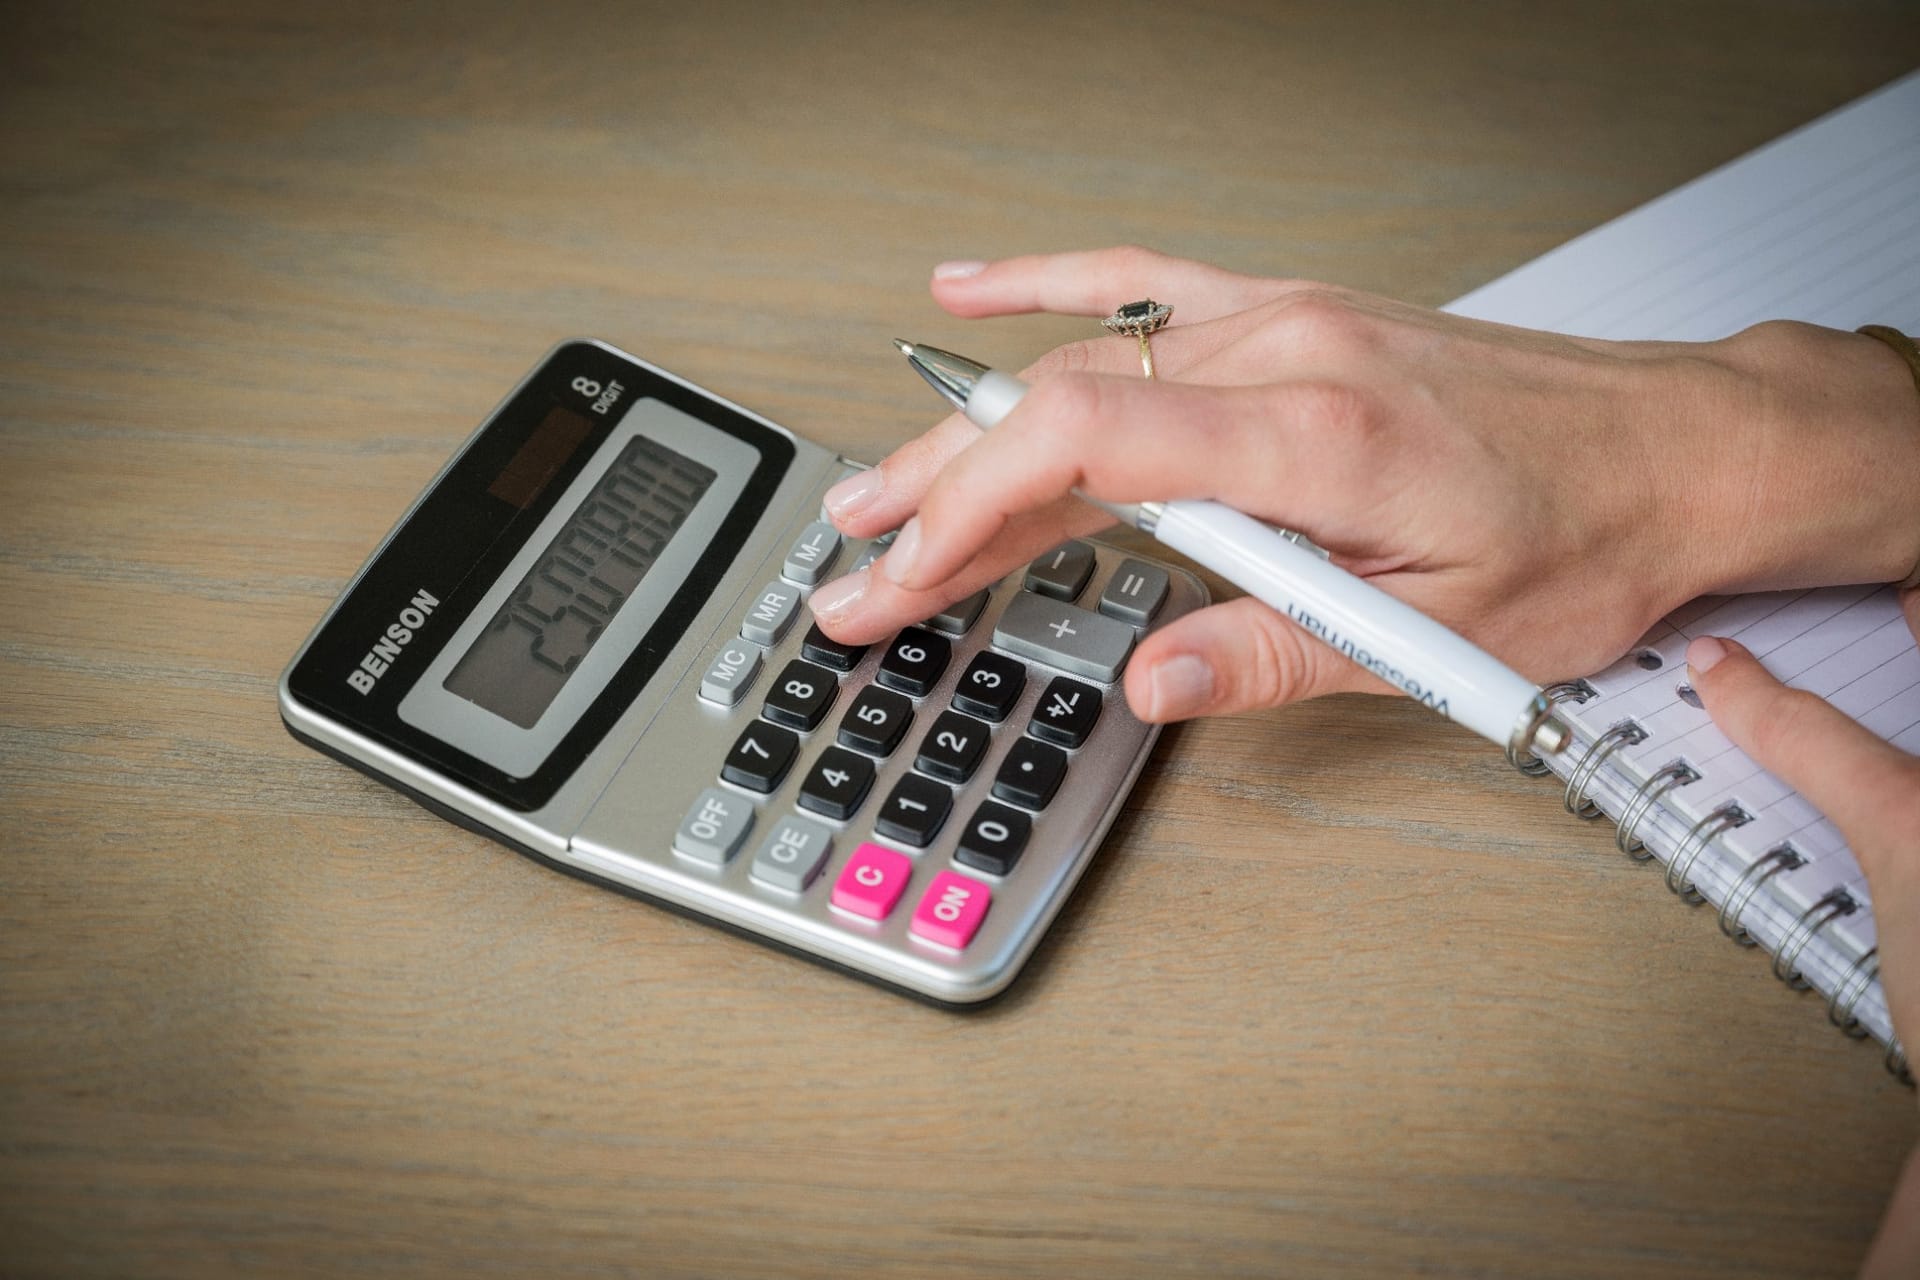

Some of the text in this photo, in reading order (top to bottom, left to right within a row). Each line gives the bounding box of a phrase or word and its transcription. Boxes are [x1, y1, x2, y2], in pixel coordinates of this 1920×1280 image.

[571, 376, 600, 398] 8
[592, 379, 626, 414] DIGIT
[753, 591, 788, 623] MR
[346, 588, 441, 696] BENSON
[898, 644, 927, 663] 6
[711, 649, 746, 682] MC
[972, 668, 1001, 688] 3
[784, 680, 814, 699] 8
[857, 704, 887, 726] 5
[741, 738, 769, 760] 7
[936, 731, 968, 752] 2
[822, 767, 850, 788] 4
[899, 798, 927, 812] 1
[691, 797, 730, 840] OFF
[772, 828, 809, 863] CE
[855, 865, 884, 887] C
[933, 886, 971, 921] ON
